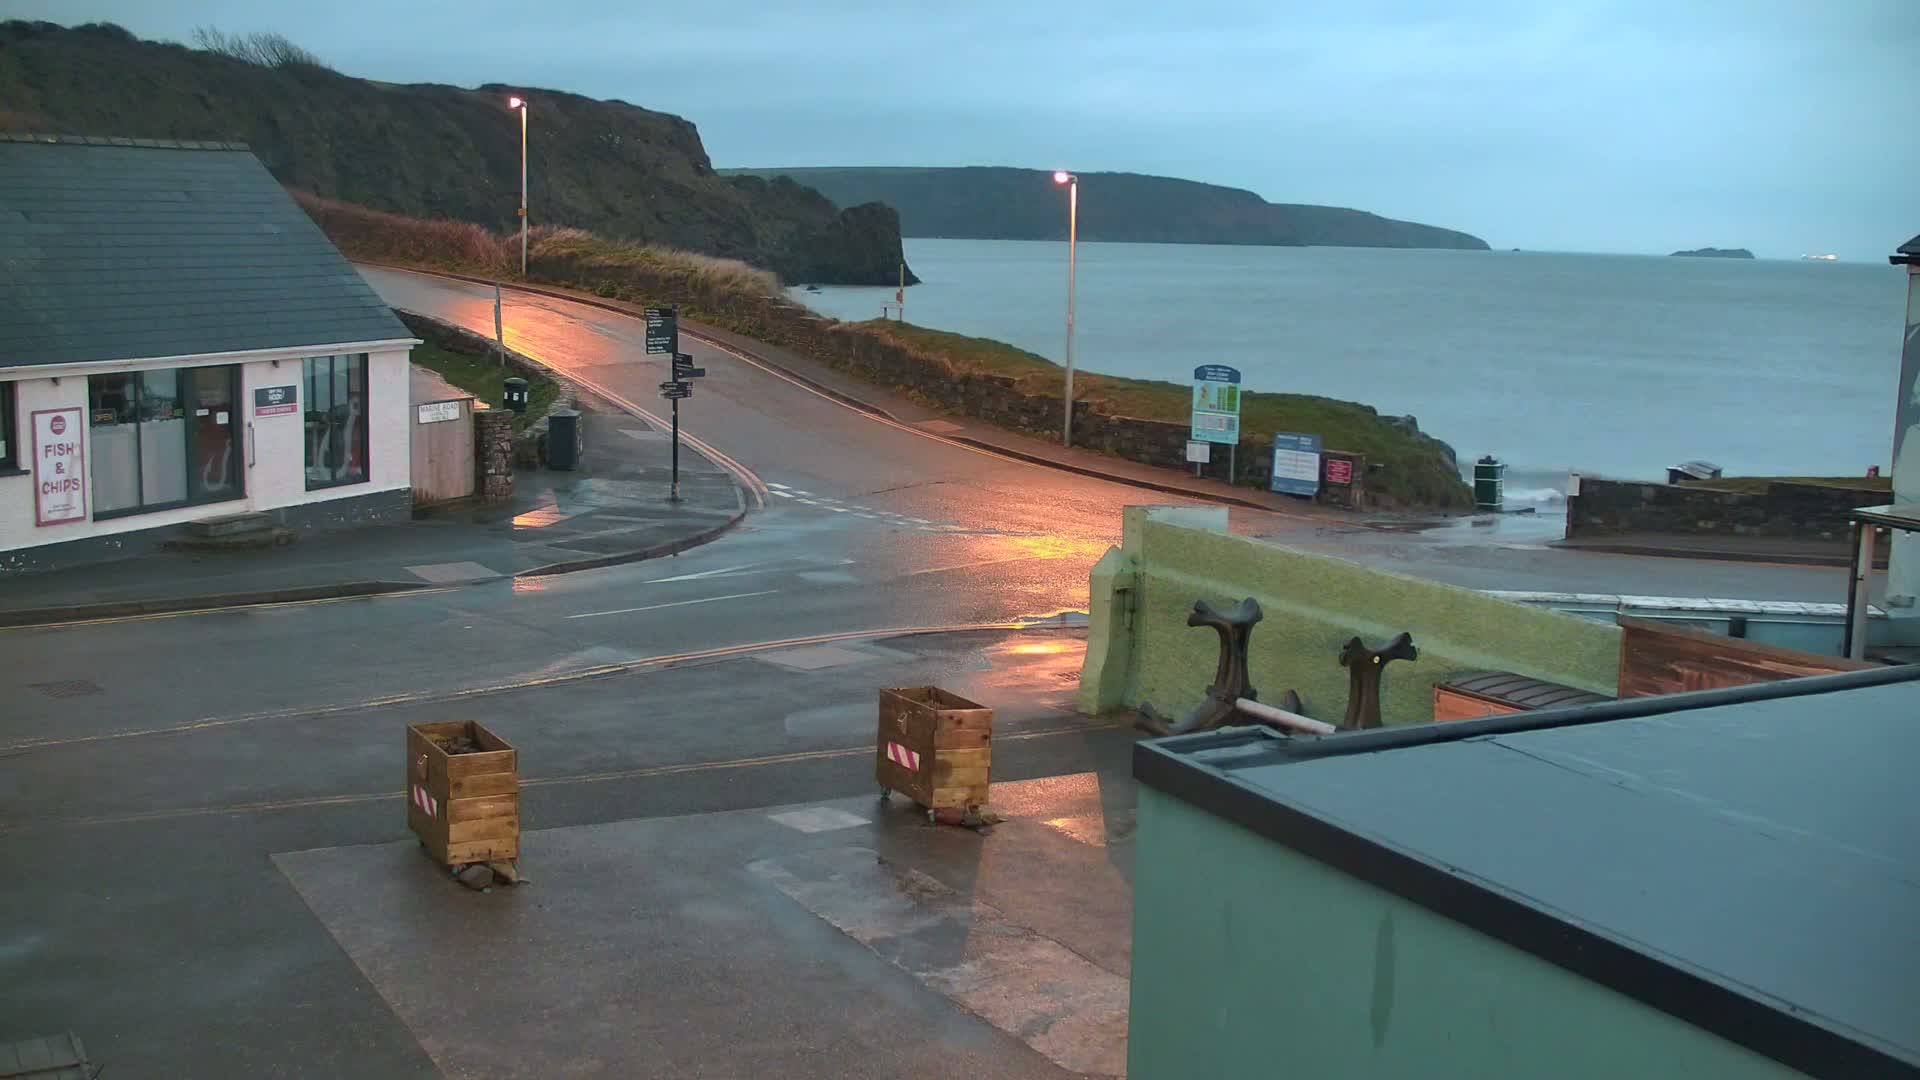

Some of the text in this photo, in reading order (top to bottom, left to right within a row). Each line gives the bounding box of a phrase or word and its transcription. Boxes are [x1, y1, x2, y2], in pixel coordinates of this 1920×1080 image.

[44, 443, 75, 458] FISH
[55, 462, 65, 474] &
[41, 478, 81, 495] CHIPS
